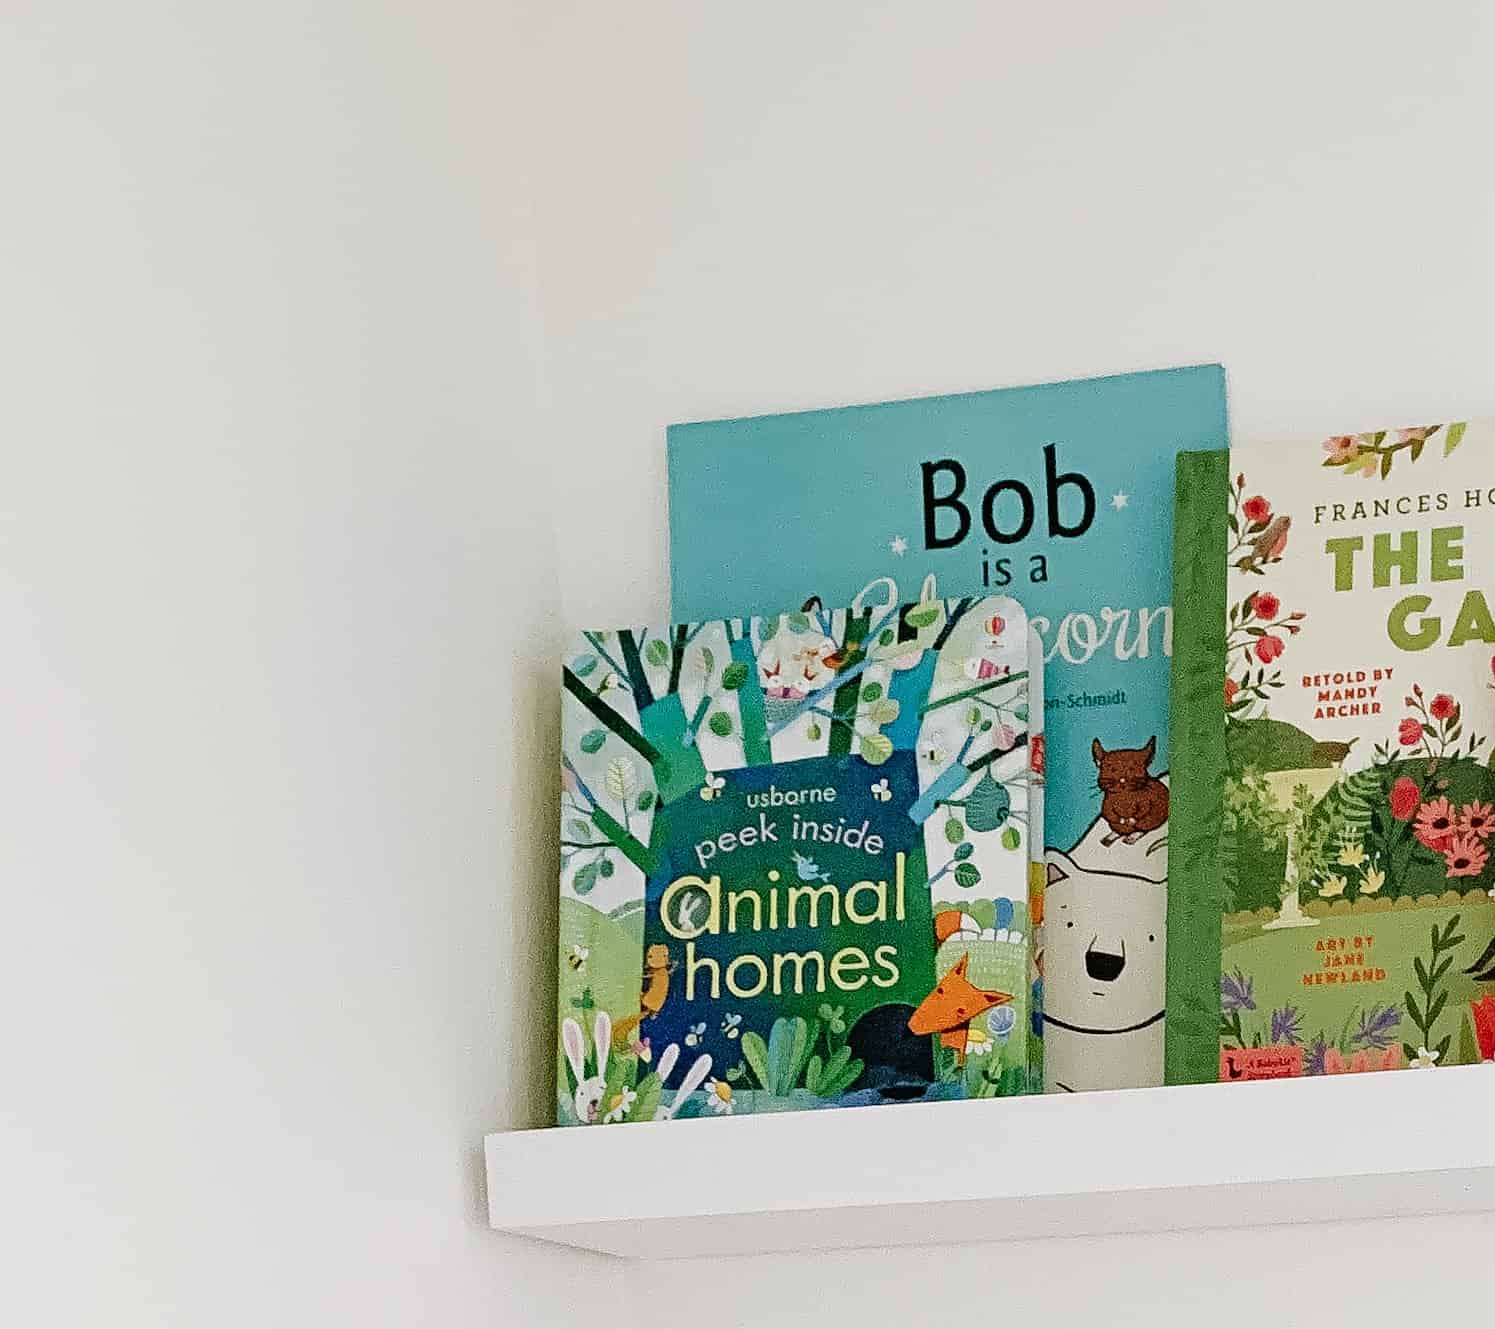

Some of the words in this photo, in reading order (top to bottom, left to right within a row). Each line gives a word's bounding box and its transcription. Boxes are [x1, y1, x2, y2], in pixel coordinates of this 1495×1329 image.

[920, 443, 1096, 550] Bob
[1314, 493, 1448, 524] FRANCES
[982, 548, 1012, 587] is
[1029, 554, 1048, 583] a
[1325, 525, 1464, 592] THE
[1302, 671, 1365, 688] RETOLD
[1373, 668, 1393, 681] BY
[1318, 686, 1377, 702] MANDY
[1314, 702, 1381, 719] ARCHER
[747, 785, 837, 808] usborne
[694, 812, 778, 869] peek
[792, 814, 884, 855] inside
[660, 852, 905, 940] animal
[685, 943, 900, 1001] homes
[1303, 967, 1387, 985] NEWLAND
